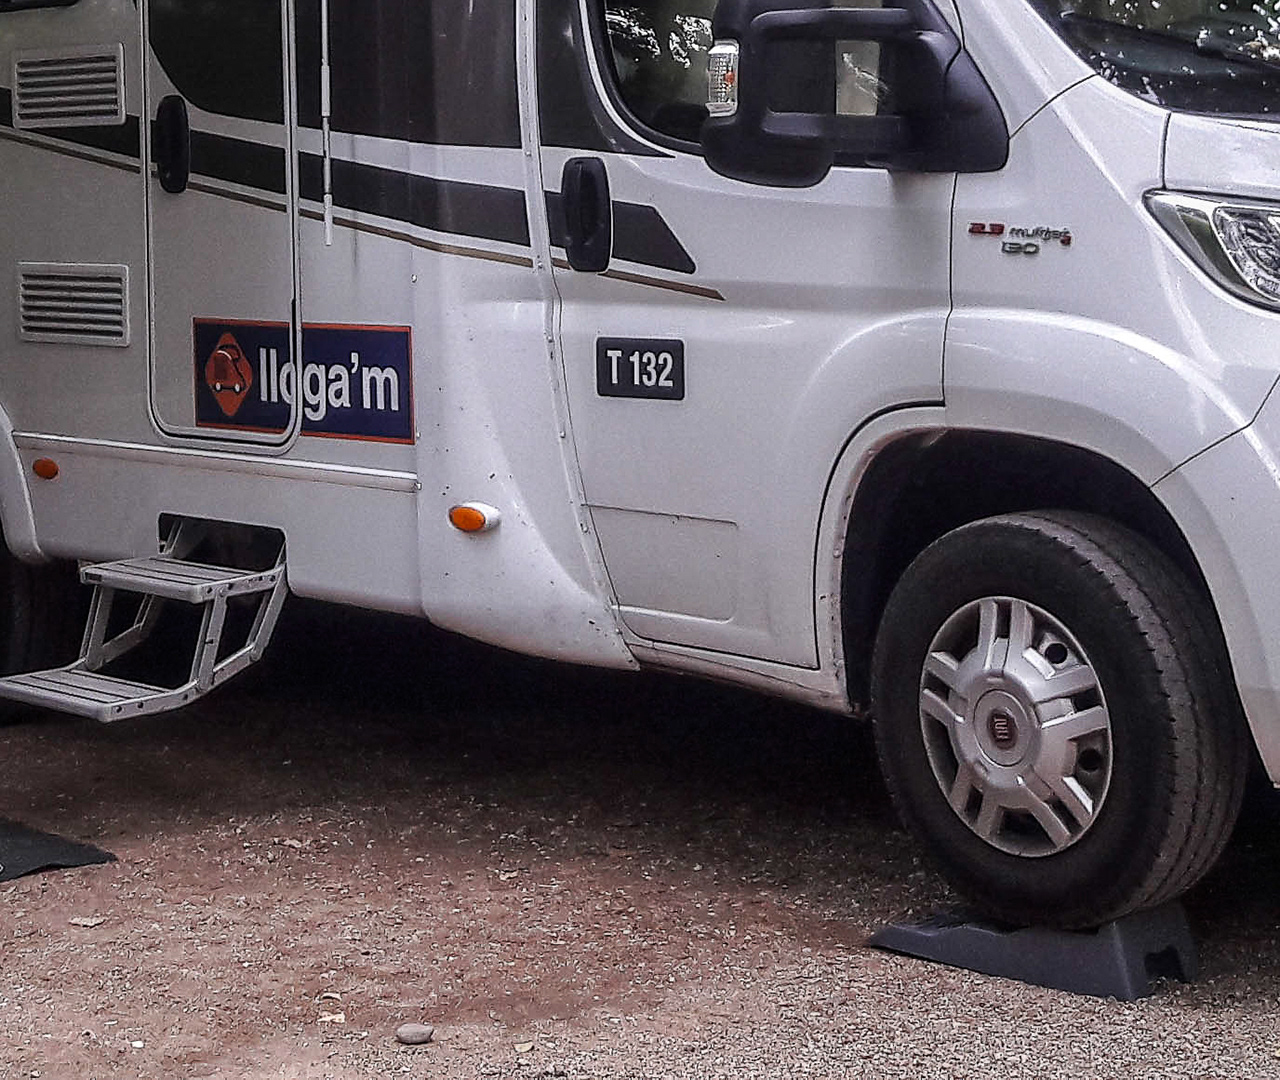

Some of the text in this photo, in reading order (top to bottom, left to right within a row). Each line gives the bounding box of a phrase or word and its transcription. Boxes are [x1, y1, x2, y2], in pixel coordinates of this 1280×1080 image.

[259, 347, 399, 421] lloga'm
[606, 349, 674, 388] T 132
